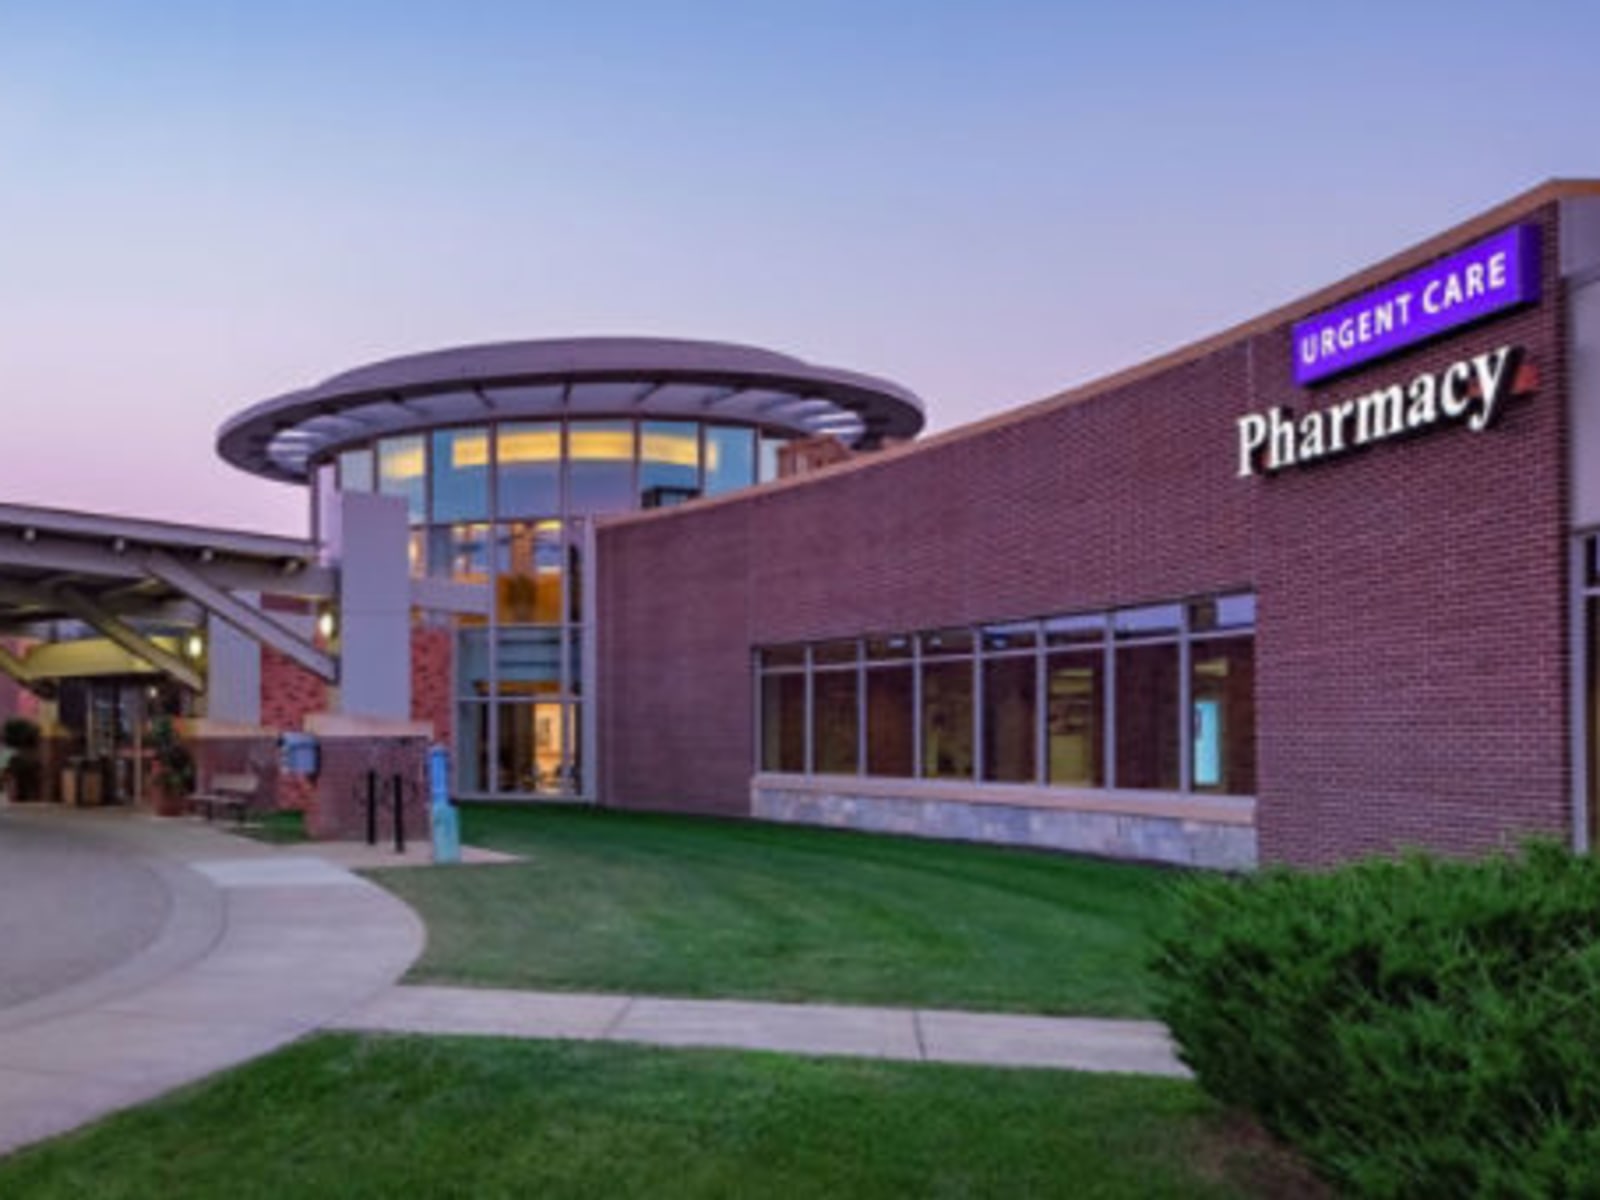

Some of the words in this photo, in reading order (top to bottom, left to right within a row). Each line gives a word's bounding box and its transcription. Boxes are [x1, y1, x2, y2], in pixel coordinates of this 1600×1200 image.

[1301, 294, 1412, 364] URGENT
[1422, 252, 1506, 314] CARE
[1237, 345, 1510, 477] Pharmacy
